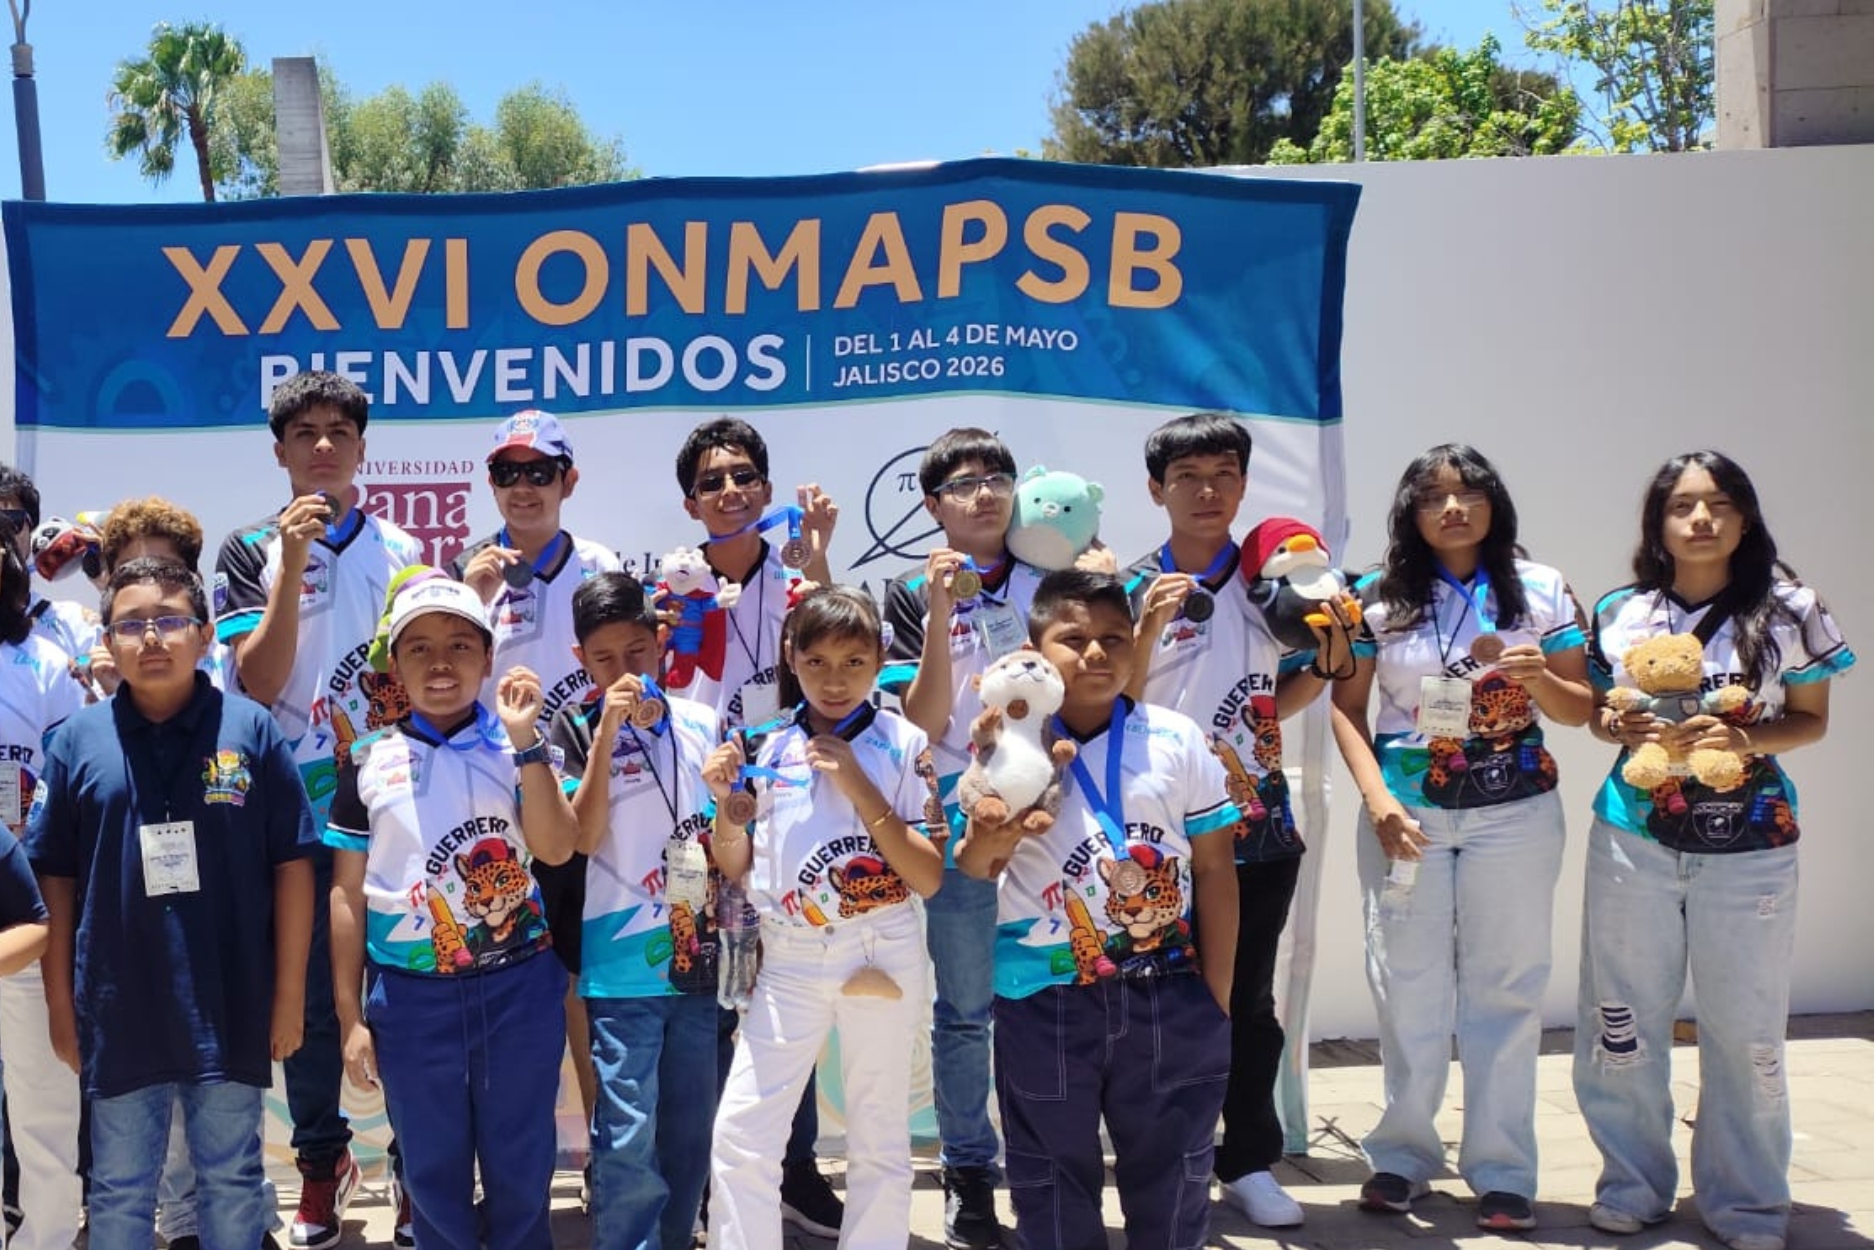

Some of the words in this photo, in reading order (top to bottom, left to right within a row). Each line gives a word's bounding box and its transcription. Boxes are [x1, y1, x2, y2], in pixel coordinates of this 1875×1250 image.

[162, 237, 468, 338] XXVI
[515, 200, 1183, 326] ONMAPSB
[835, 333, 883, 357] DEL
[890, 332, 904, 353] 1
[909, 329, 940, 351] AL
[945, 326, 960, 347] 4
[966, 324, 1001, 345] DE
[1005, 326, 1078, 352] MAYO
[833, 359, 942, 388] JALISCO
[946, 356, 1005, 379] 2026
[356, 460, 474, 477] NIVERSIDAD
